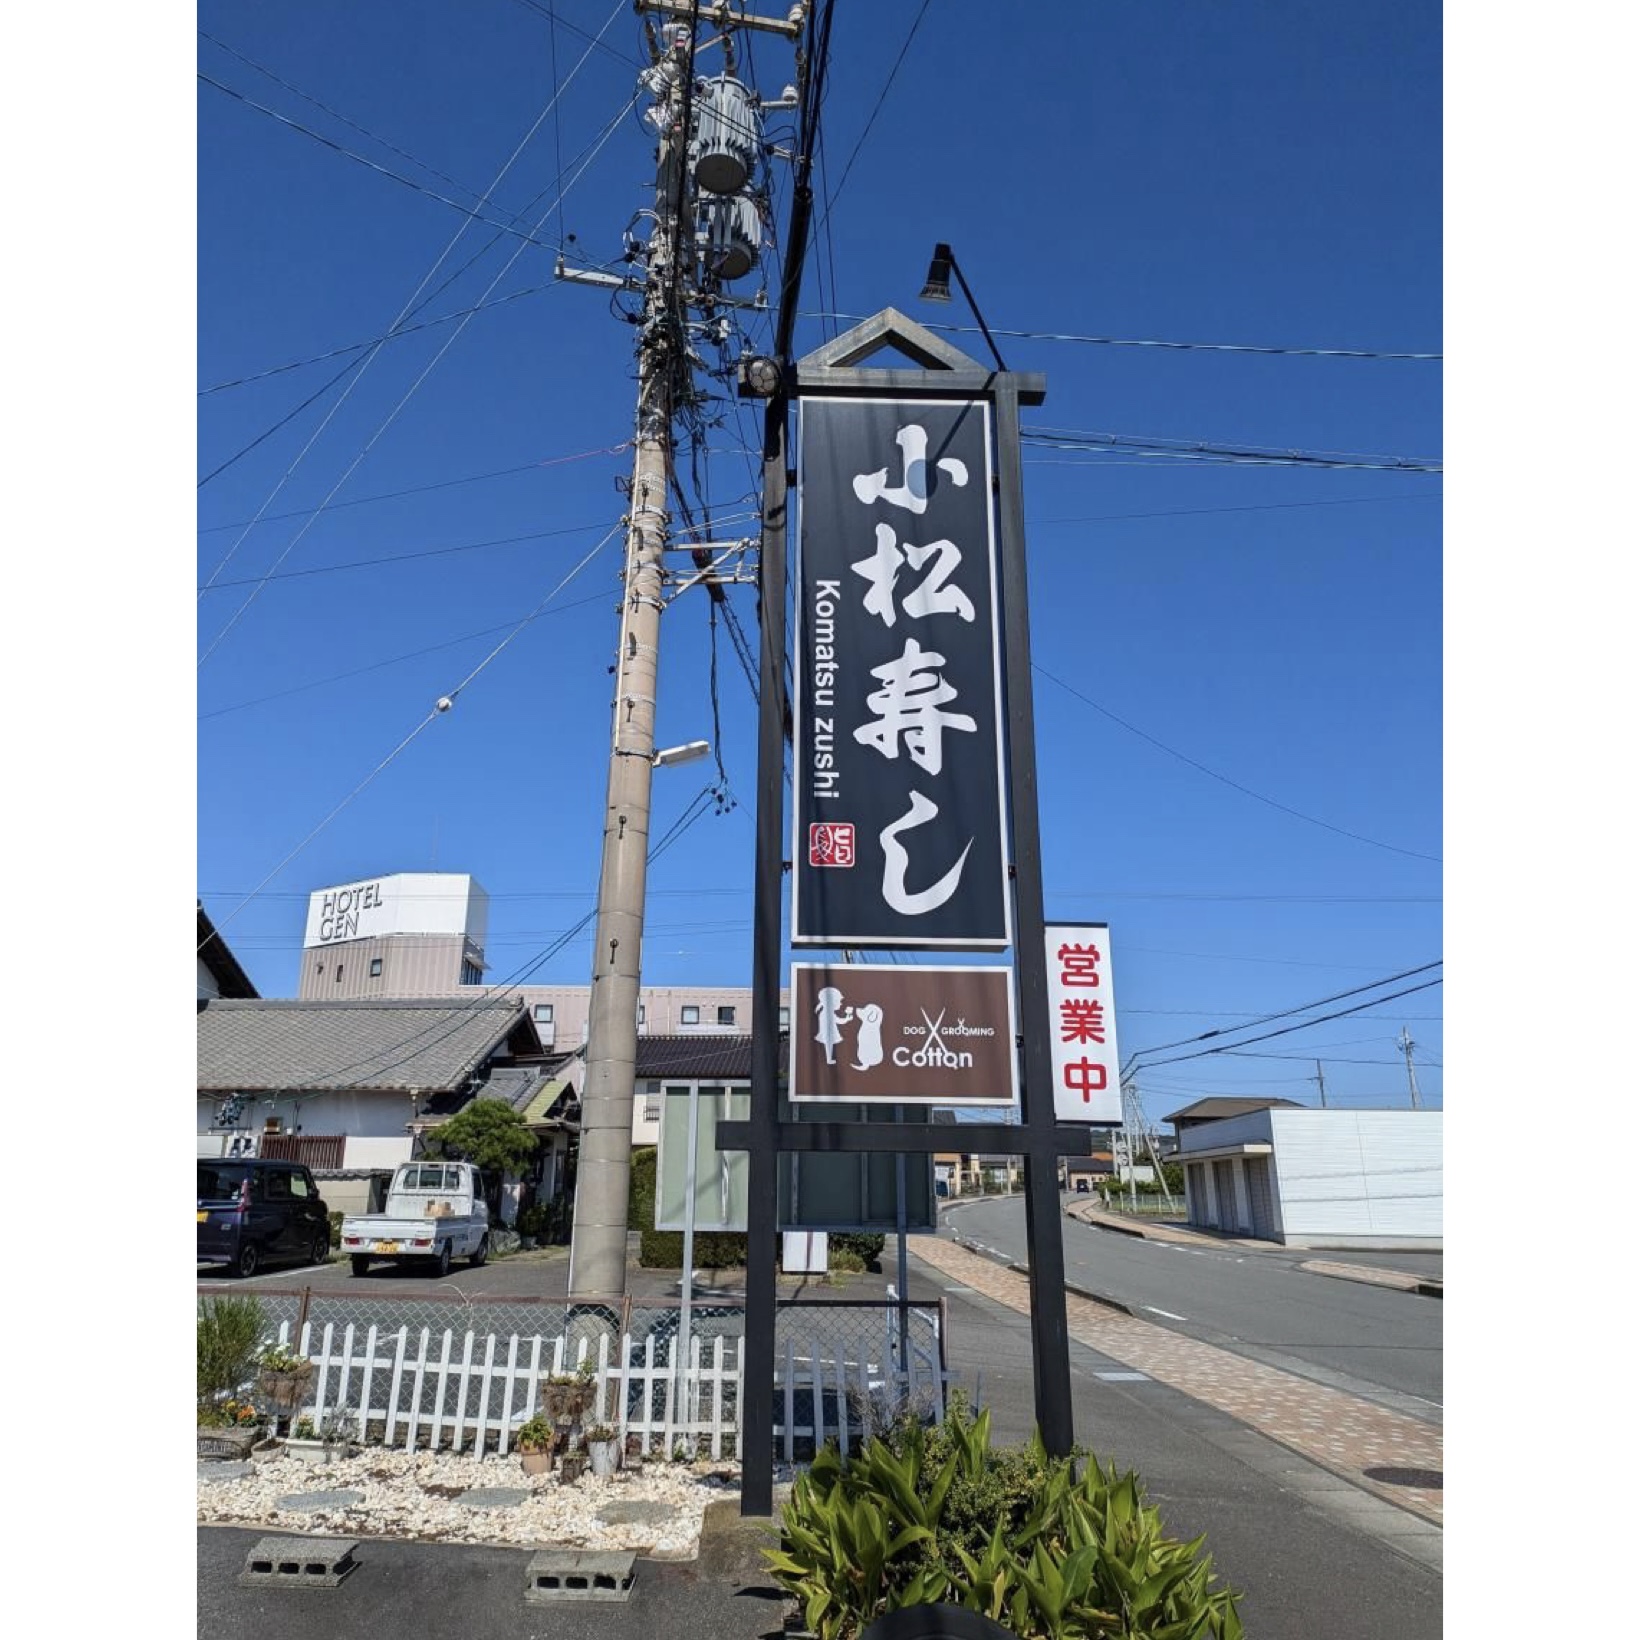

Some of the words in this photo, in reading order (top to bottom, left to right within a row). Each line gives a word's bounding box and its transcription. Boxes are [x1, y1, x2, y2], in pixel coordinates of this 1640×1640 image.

[815, 579, 841, 706] Komatsu
[851, 424, 978, 916] 小松寿し
[813, 717, 841, 799] zushi
[320, 912, 360, 941] GEN
[321, 883, 383, 918] HOTEL
[903, 1026, 926, 1035] DOG
[941, 1026, 995, 1036] GROOMING
[1058, 943, 1106, 1101] 営業中
[892, 1046, 973, 1070] Cotton
